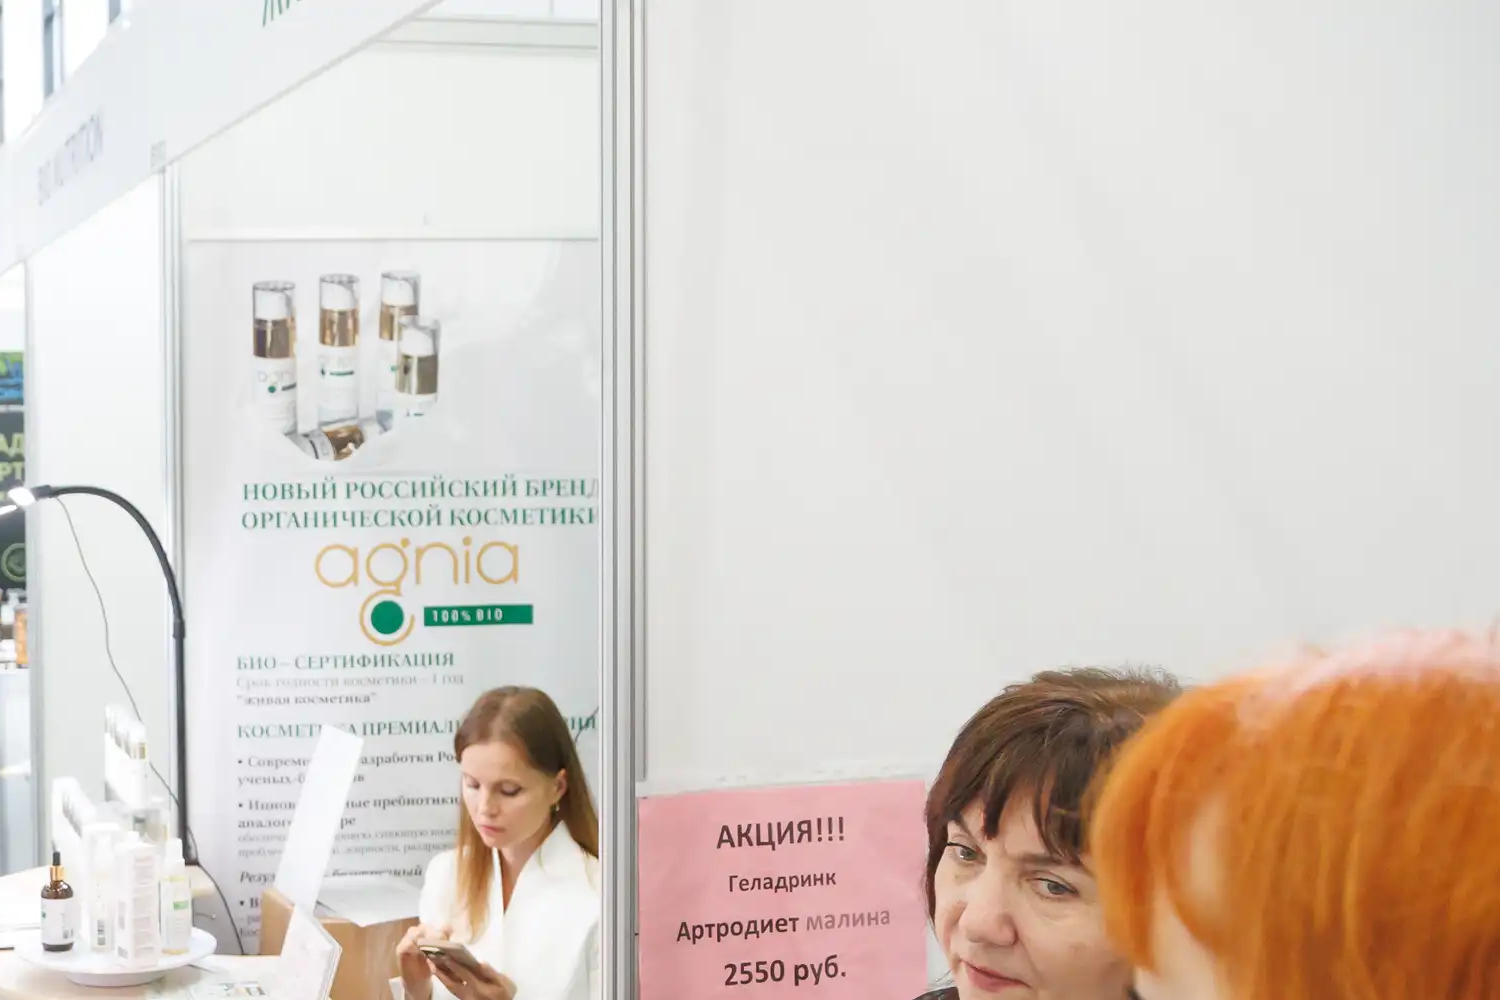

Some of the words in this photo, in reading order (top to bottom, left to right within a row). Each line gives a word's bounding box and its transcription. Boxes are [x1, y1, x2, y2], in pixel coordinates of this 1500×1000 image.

[243, 475, 337, 501] НОВЫЙ
[346, 474, 517, 500] РОССИЙСКИЙ
[241, 504, 442, 530] ОРГАНИЧЕСКОЙ
[314, 536, 520, 646] agnia
[431, 608, 472, 623] 100%
[294, 652, 455, 670] СЕРТИФИКАЦИЯ
[360, 752, 434, 767] азработки
[716, 816, 845, 851] АКЦИЯ!!!
[728, 871, 837, 893] Геладринк
[676, 916, 800, 945] Артродиет
[806, 910, 891, 931] малина
[724, 959, 785, 987] 2550
[793, 954, 847, 986] руб.
